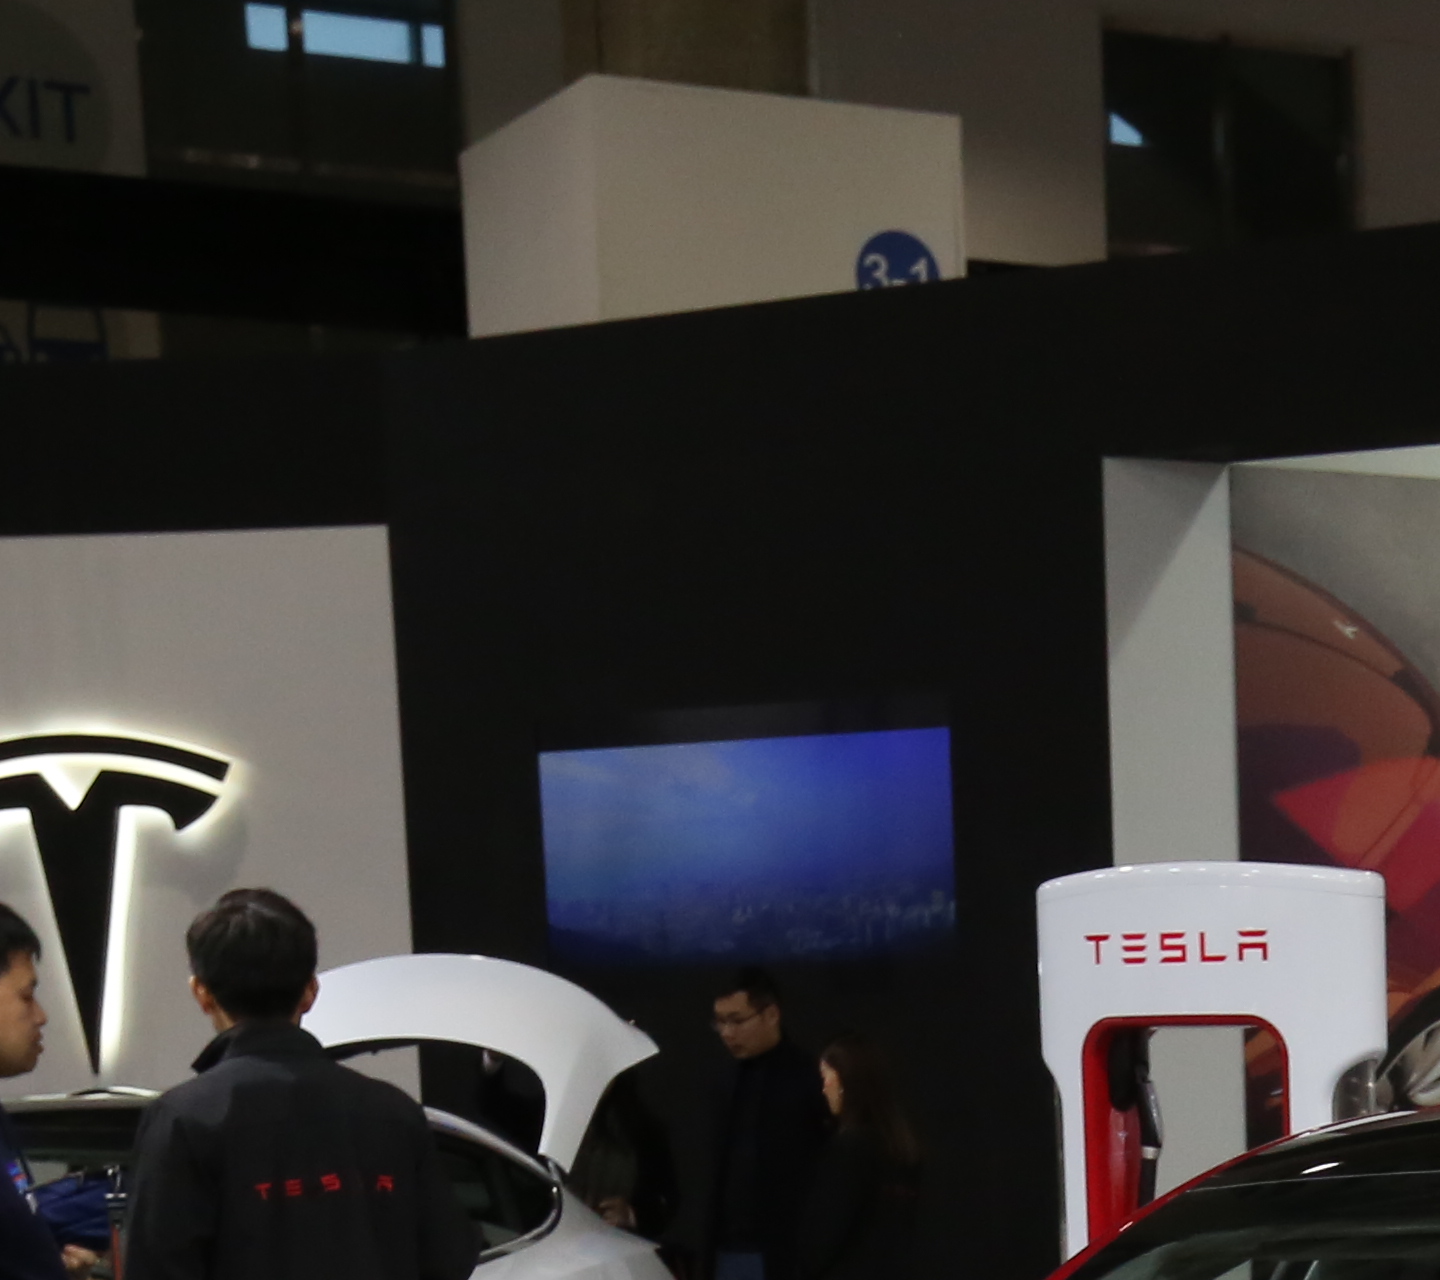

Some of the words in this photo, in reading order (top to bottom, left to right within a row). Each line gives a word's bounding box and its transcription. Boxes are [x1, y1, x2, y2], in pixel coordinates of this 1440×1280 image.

[863, 253, 928, 290] 3-1
[1084, 928, 1269, 965] TESLA
[254, 1173, 395, 1200] TESA
